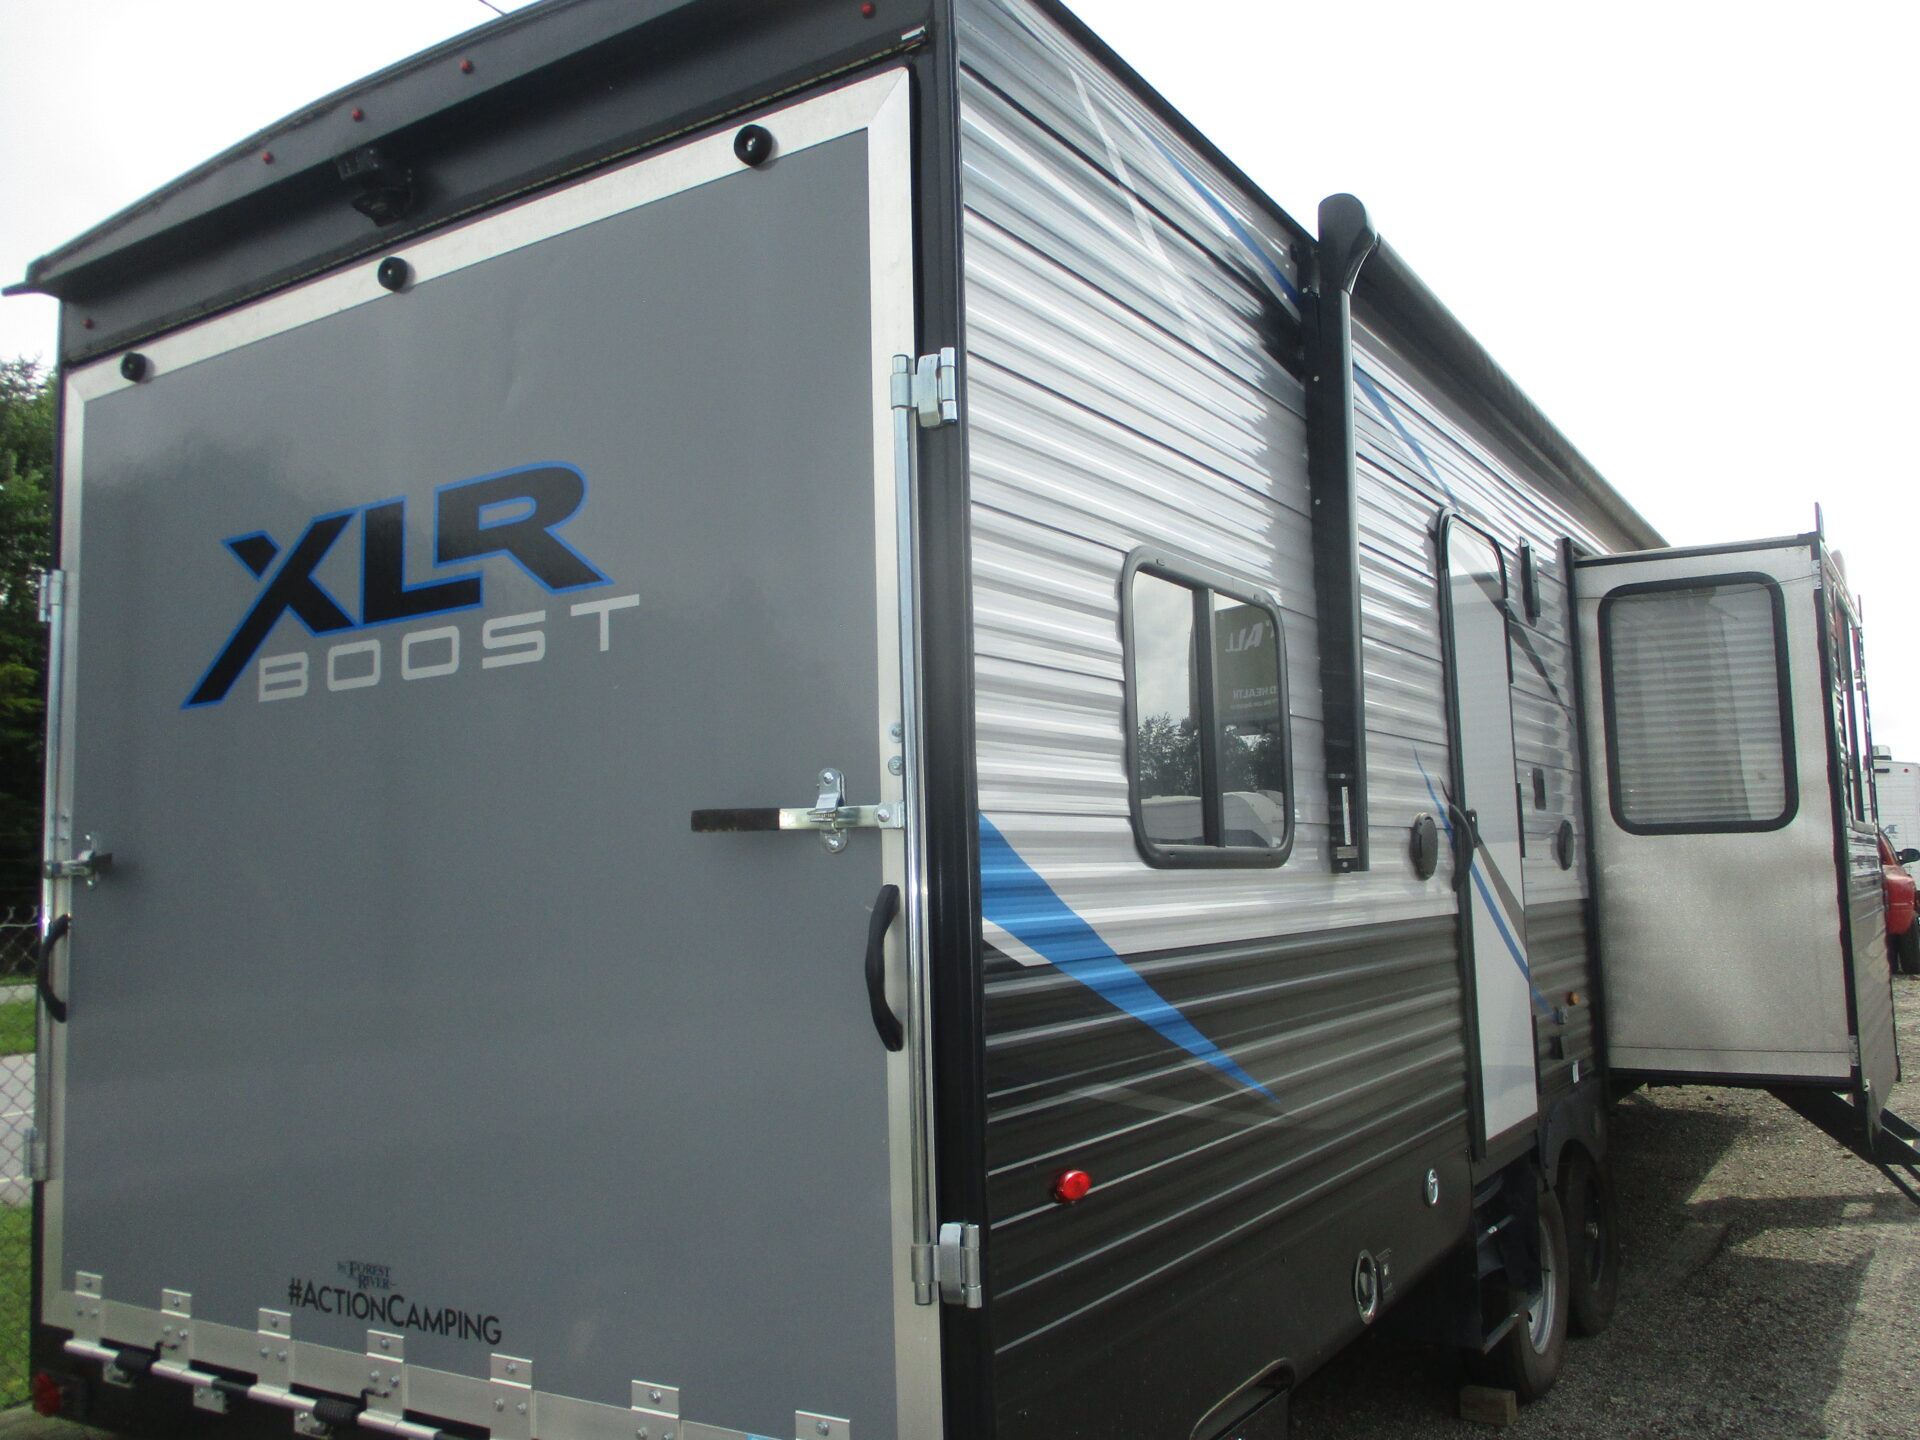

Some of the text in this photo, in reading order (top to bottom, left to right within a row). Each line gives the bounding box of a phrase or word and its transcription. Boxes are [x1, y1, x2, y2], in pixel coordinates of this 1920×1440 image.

[179, 460, 614, 710] XLR
[258, 594, 640, 702] BOOST
[350, 1261, 392, 1277] FOREST
[358, 1273, 390, 1289] RIVER
